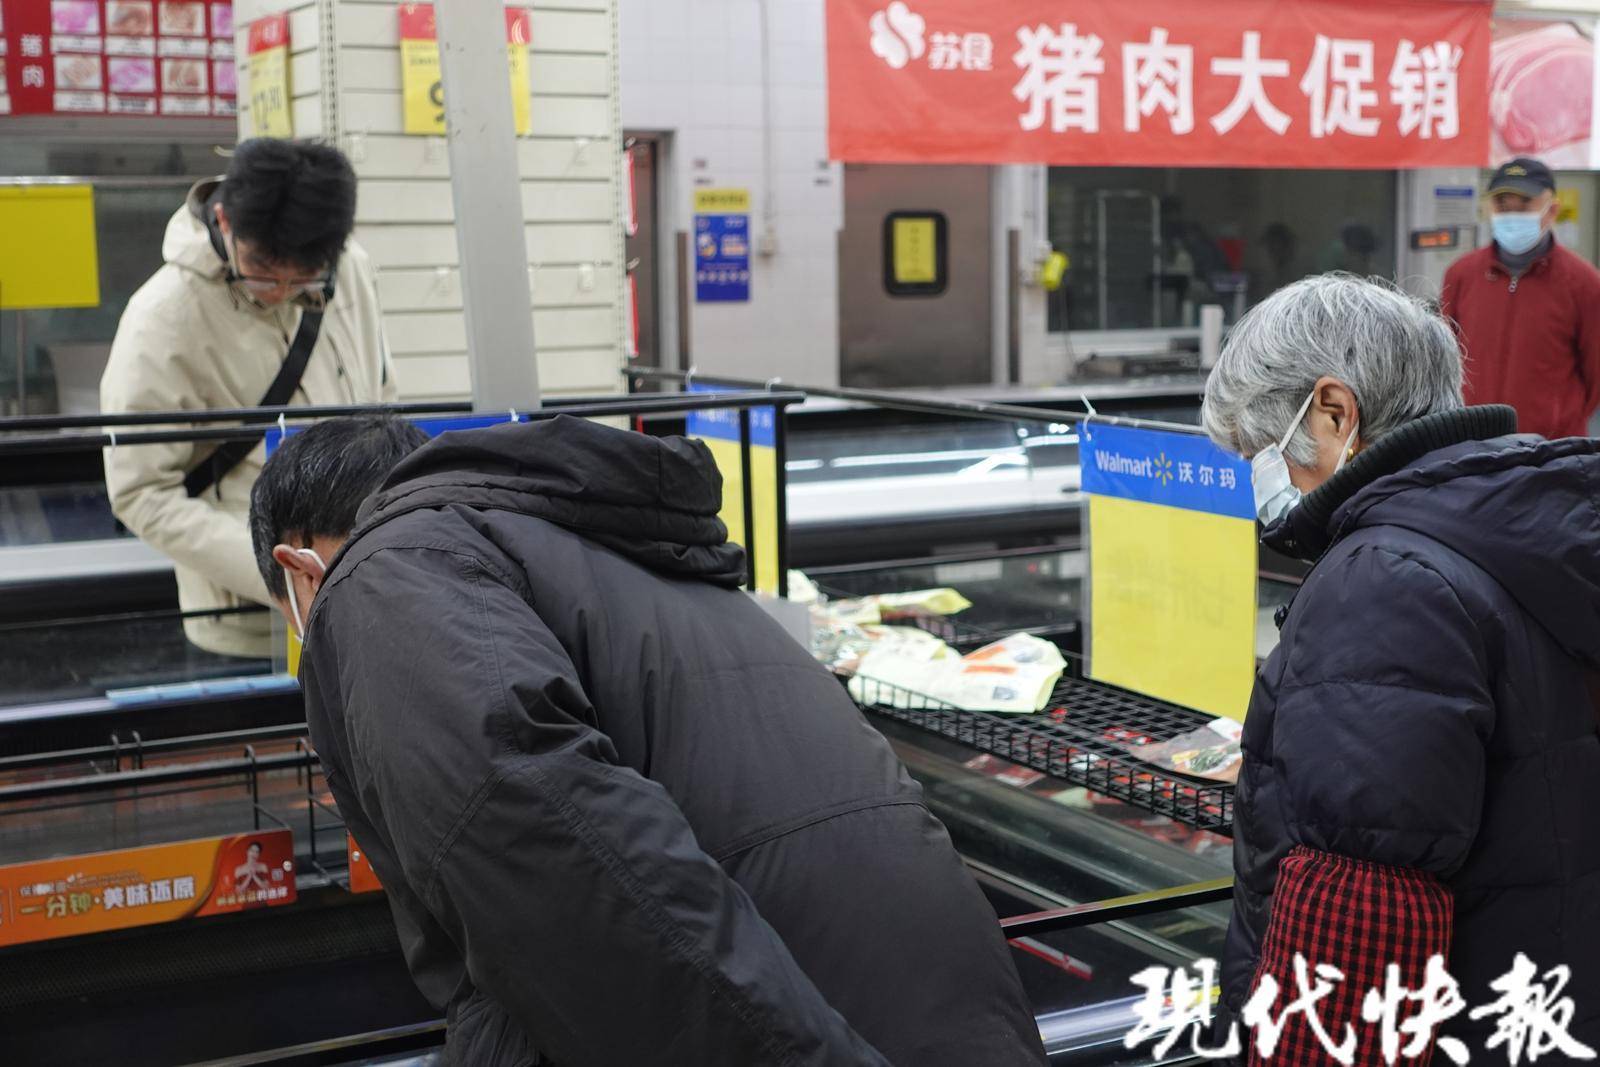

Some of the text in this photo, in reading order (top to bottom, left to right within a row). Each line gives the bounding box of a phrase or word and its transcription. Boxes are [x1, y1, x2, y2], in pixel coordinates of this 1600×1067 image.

[20, 33, 45, 88] 猪肉
[928, 31, 993, 72] 苏食
[1013, 23, 1462, 141] 猪肉大促销
[1095, 449, 1153, 479] Walmart
[1177, 461, 1237, 491] 沃尔玛
